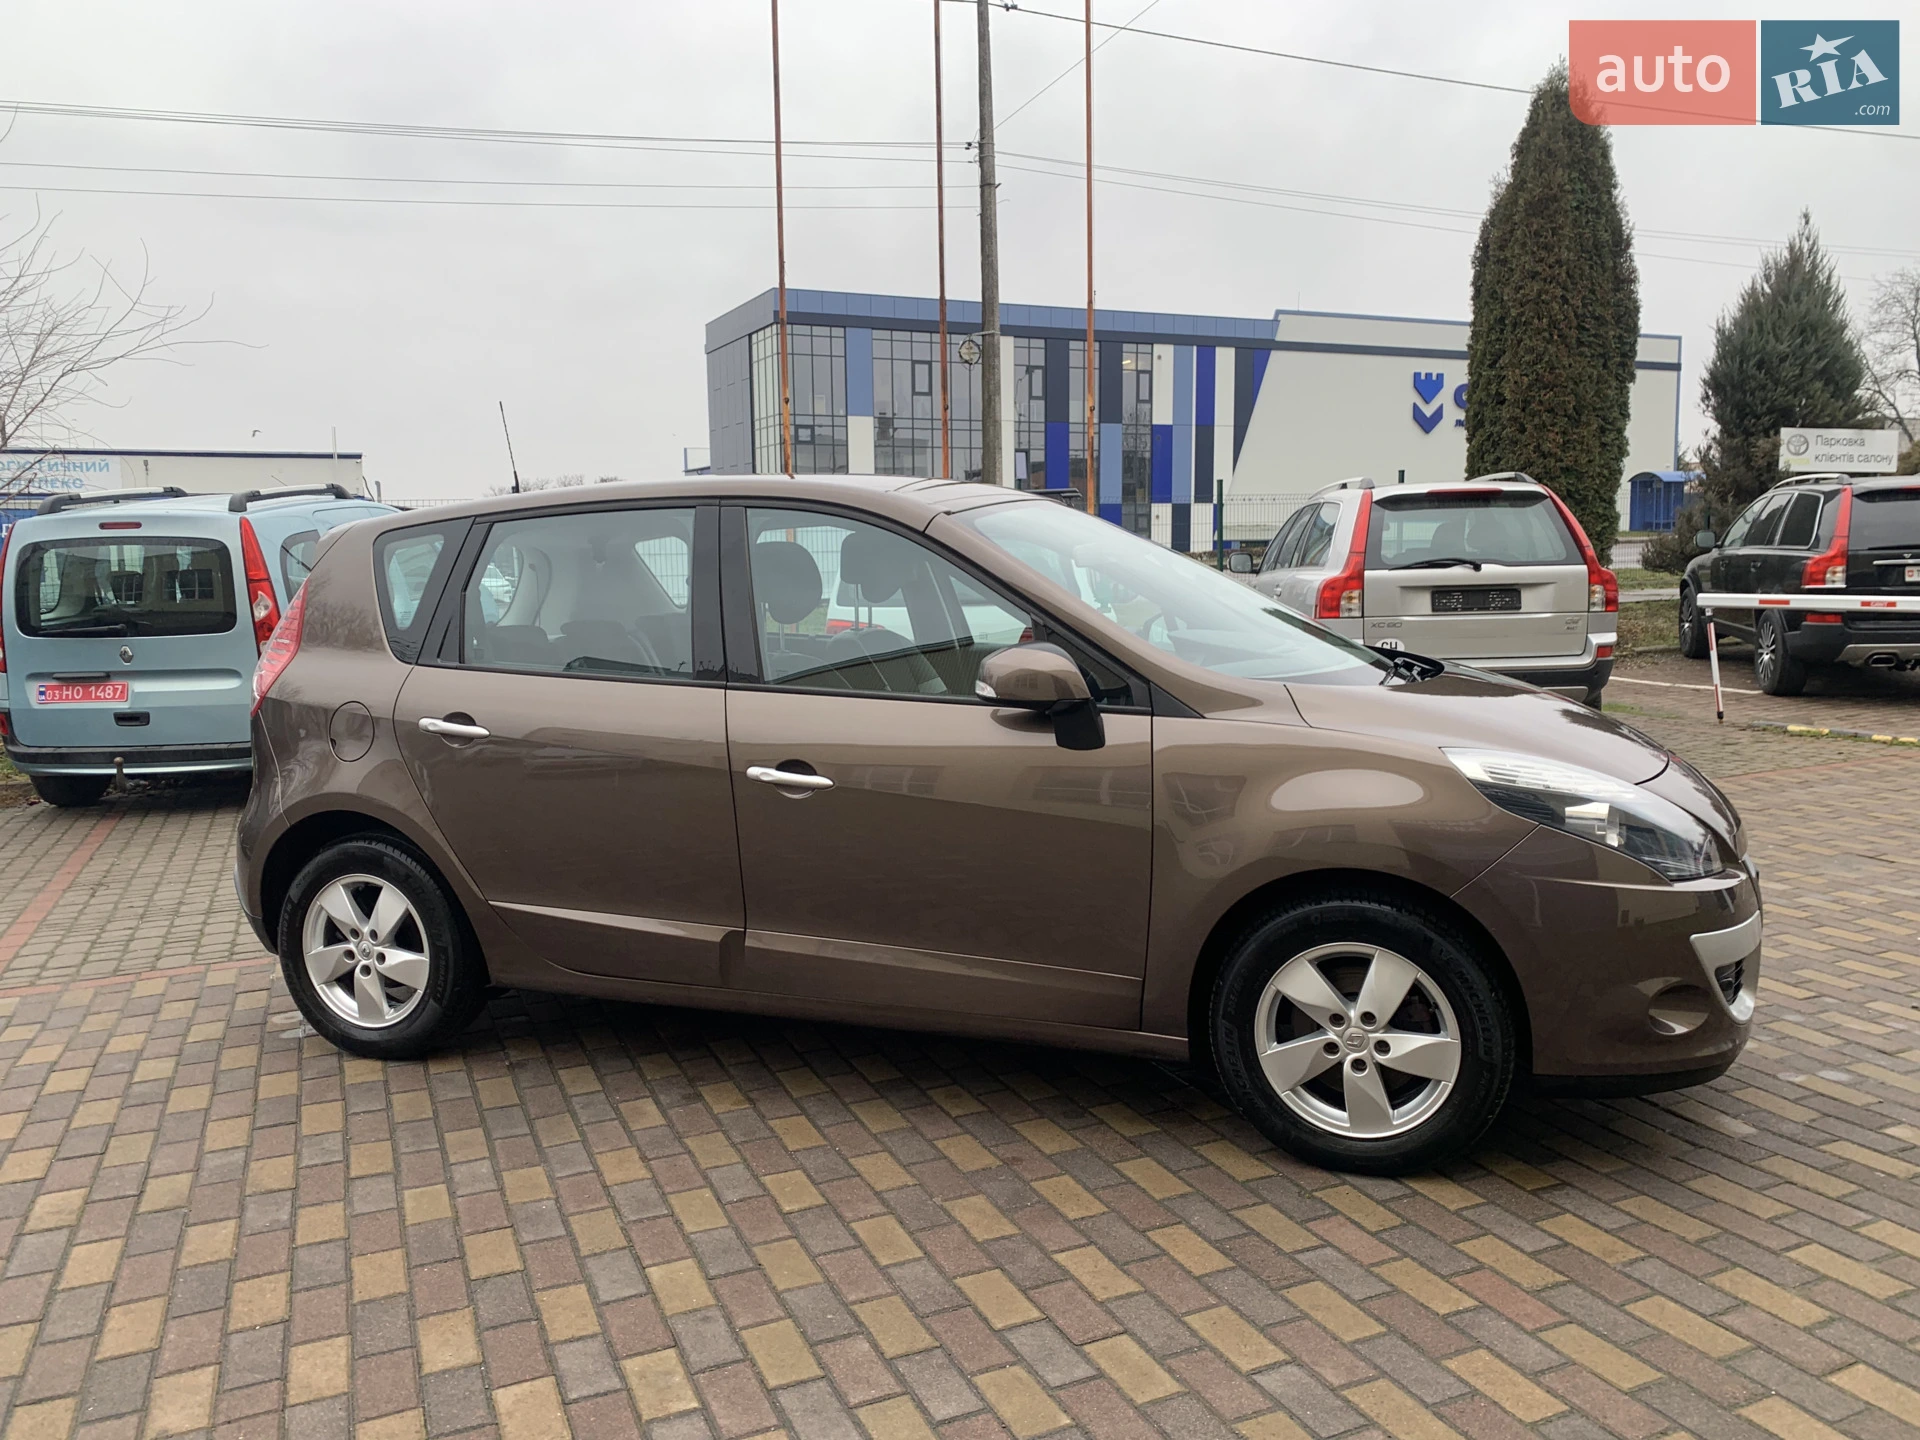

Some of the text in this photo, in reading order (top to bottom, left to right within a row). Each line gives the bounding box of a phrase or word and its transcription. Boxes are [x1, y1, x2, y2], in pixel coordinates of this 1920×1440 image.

[1815, 434, 1865, 448] Парковка
[1814, 453, 1894, 466] клієнтів салону
[89, 685, 122, 699] 1487
